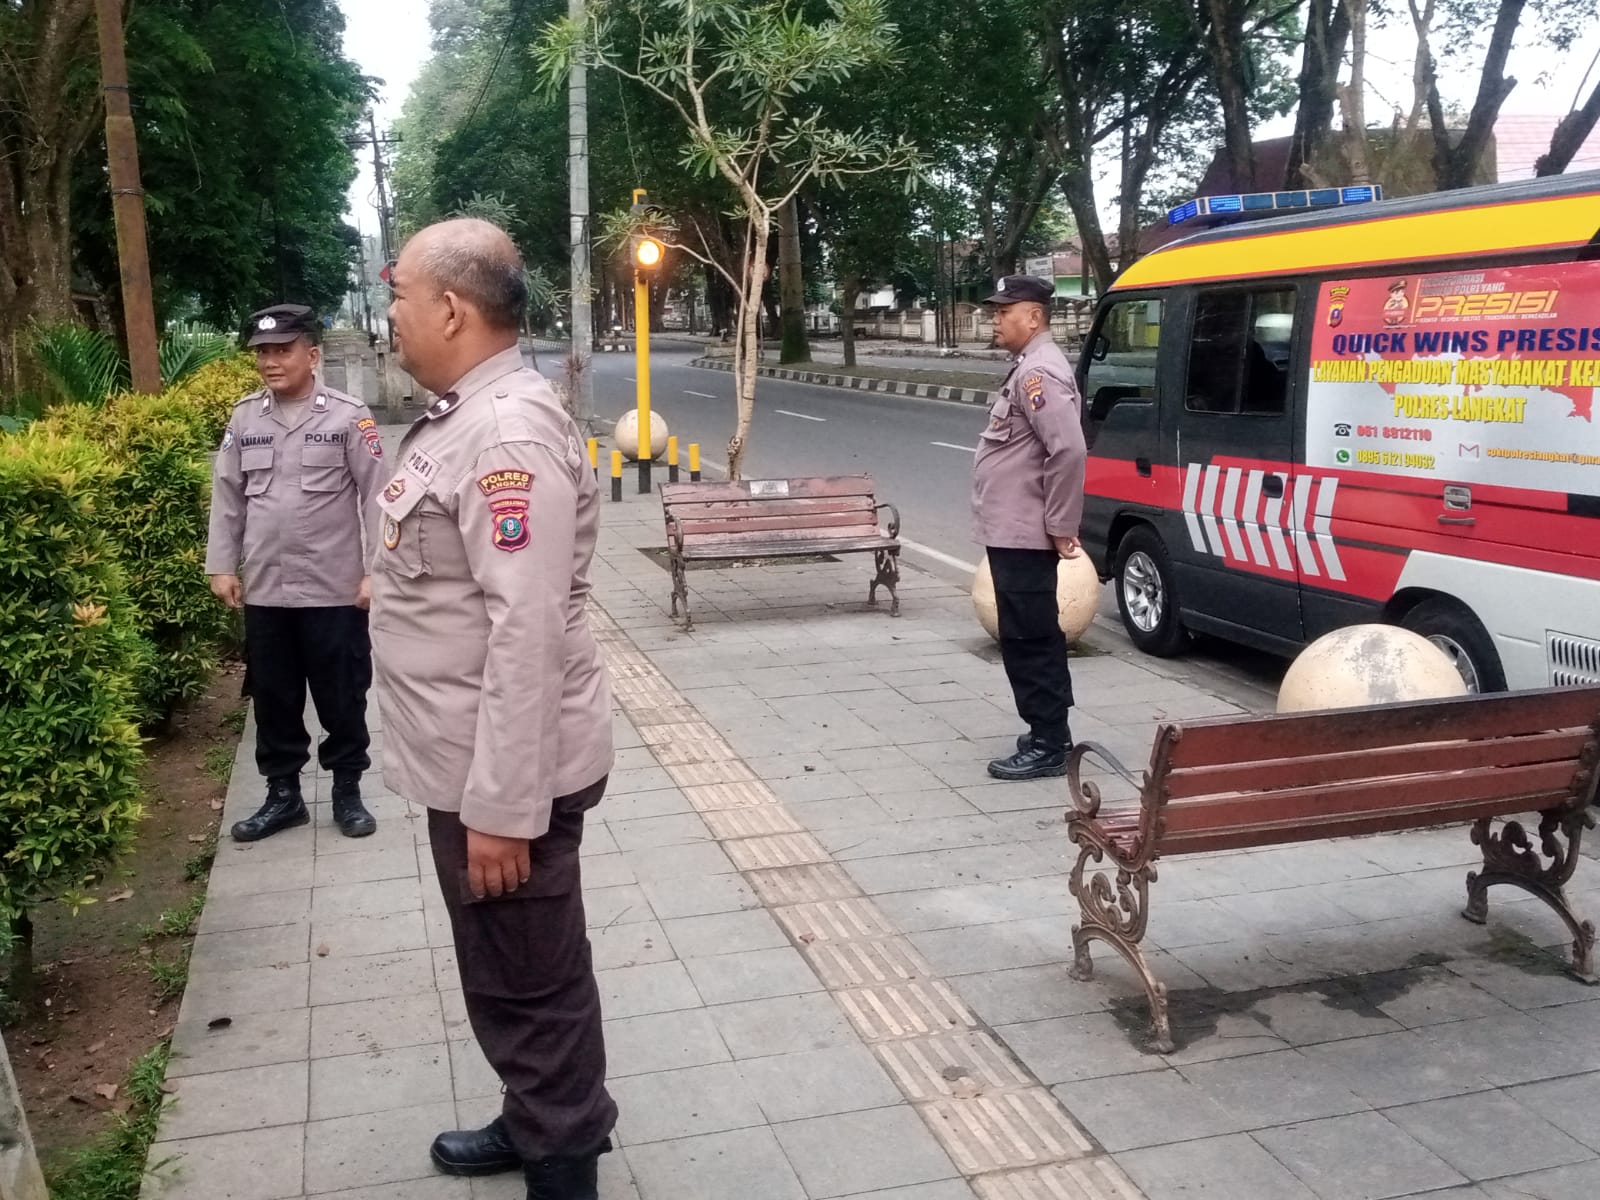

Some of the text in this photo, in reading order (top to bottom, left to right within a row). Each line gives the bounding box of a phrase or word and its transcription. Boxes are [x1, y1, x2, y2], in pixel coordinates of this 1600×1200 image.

[1454, 284, 1480, 294] POLRI
[1481, 282, 1506, 293] YANG
[1416, 290, 1559, 318] PRESISI
[1333, 332, 1407, 355] QUICK
[1414, 330, 1489, 353] WINS
[1313, 360, 1366, 384] LAYANAN
[1368, 360, 1454, 385] PENGADUAN
[1456, 360, 1568, 386] MASYARAKAT
[1394, 393, 1528, 423] POLRES LANGKAT
[304, 433, 344, 444] POLRI
[408, 452, 433, 478] POLRI
[480, 471, 530, 488] POLRES
[484, 481, 529, 492] LANGKAT
